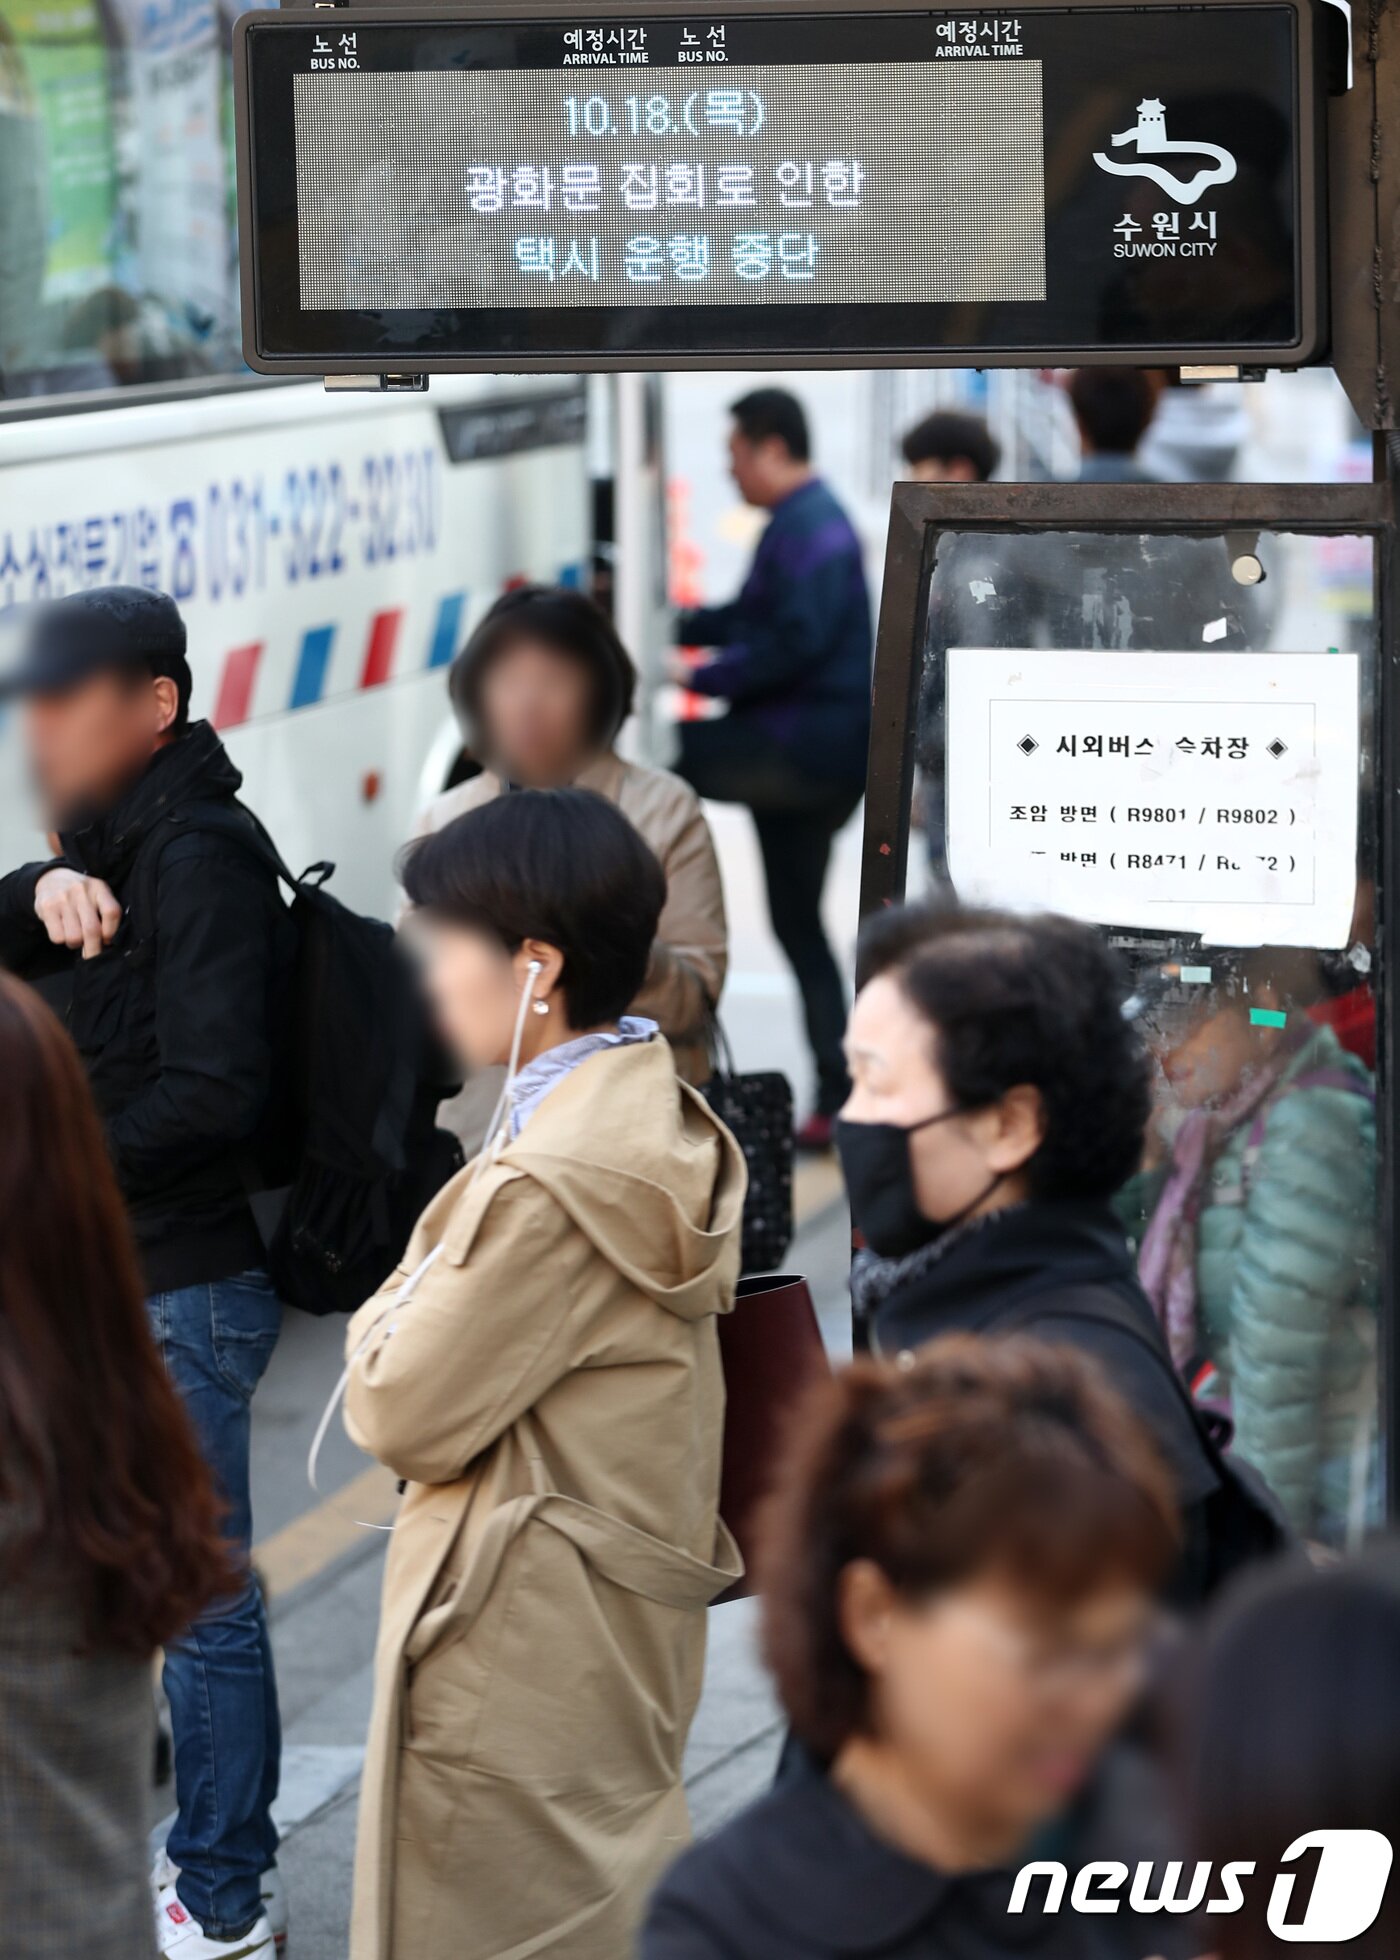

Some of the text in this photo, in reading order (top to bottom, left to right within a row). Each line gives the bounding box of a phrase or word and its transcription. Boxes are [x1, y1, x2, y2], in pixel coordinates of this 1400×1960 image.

[563, 27, 648, 52] 예정시간
[935, 20, 1022, 44] 예정시간
[562, 50, 649, 65] ARRIVAL TIME
[677, 50, 729, 64] BUS NO.
[935, 43, 1024, 58] ARRIVAL TIME
[310, 57, 361, 70] BUS NO.
[564, 90, 767, 138] 10.18.(목)
[465, 159, 866, 213] 광화문 집회로 인한
[514, 233, 820, 282] 택시 운행 중단
[1113, 243, 1217, 258] SUWON CITY
[1056, 734, 1155, 758] 시외버스
[1009, 804, 1048, 823] 조암
[1060, 805, 1098, 823] 방면
[1127, 807, 1186, 823] R9801
[1217, 809, 1278, 824] R9802
